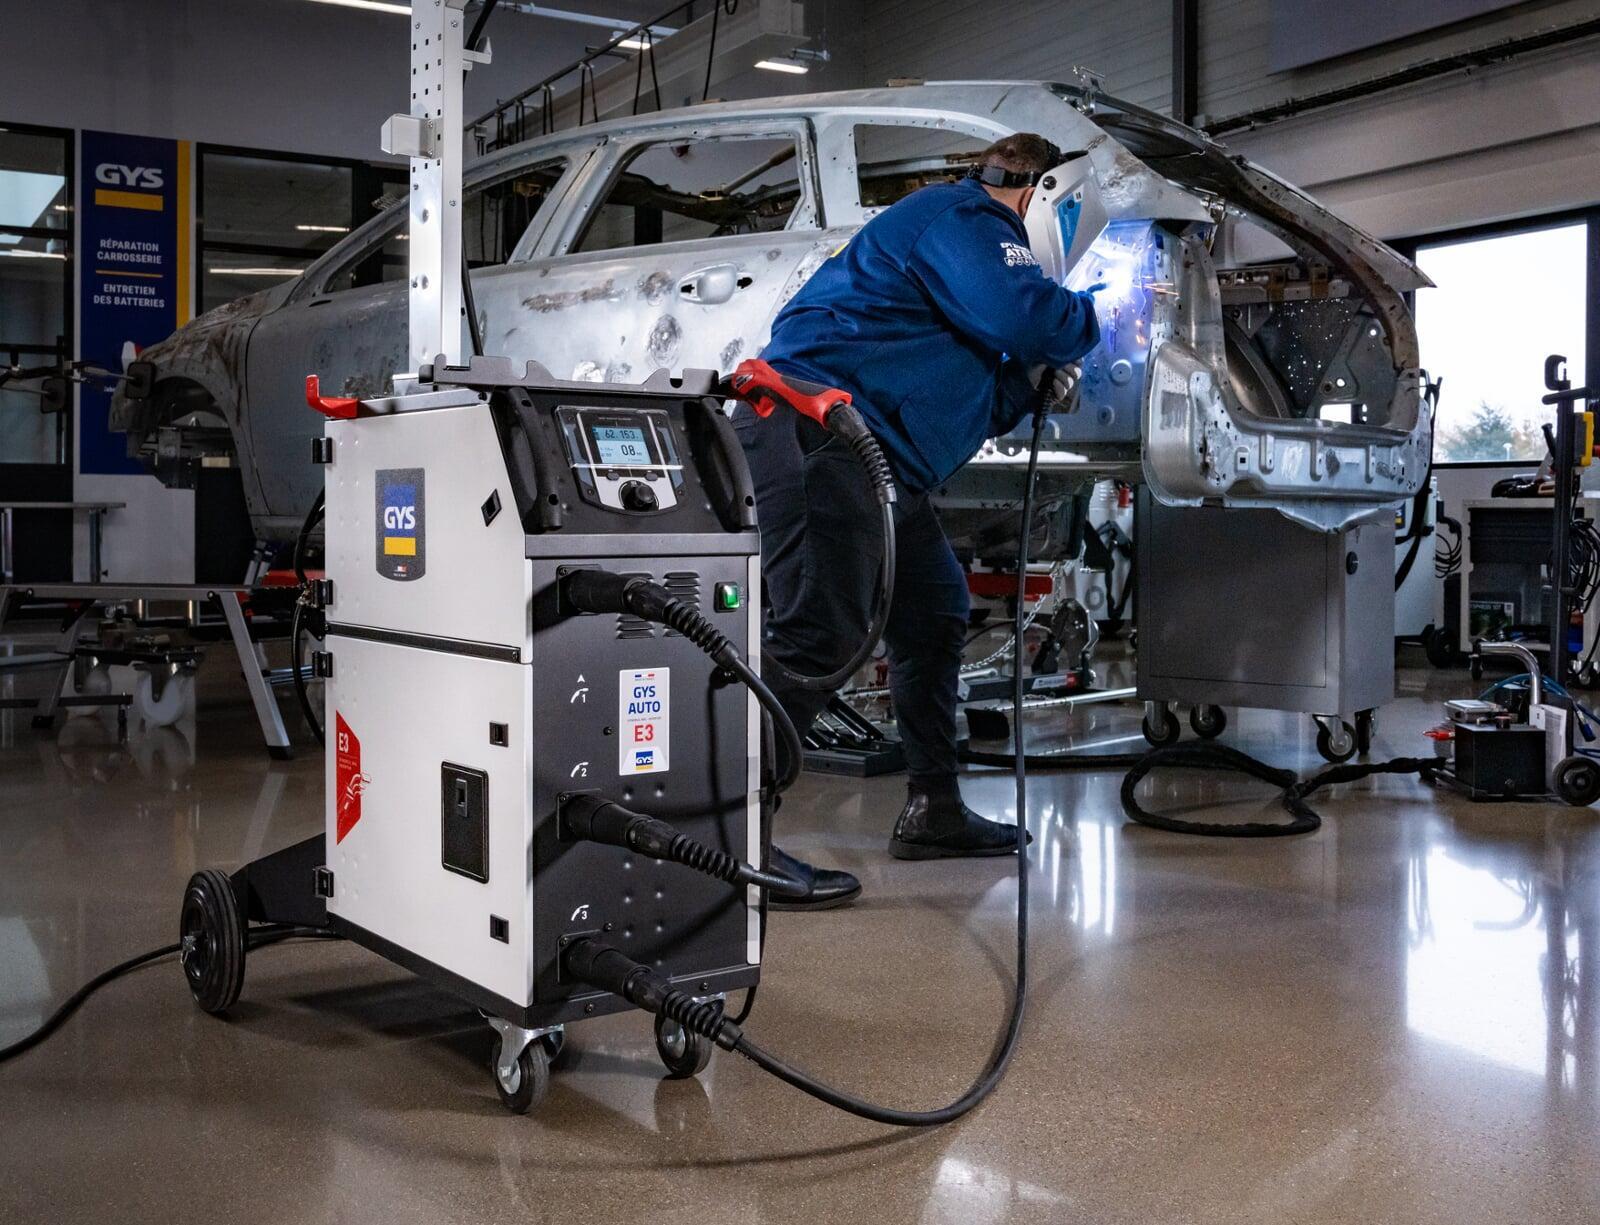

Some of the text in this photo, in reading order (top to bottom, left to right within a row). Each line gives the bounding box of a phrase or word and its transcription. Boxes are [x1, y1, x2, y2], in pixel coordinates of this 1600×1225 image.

[95, 163, 164, 188] GYS
[100, 238, 160, 252] RÉPARATION
[97, 251, 162, 265] CARROSSERIE
[103, 283, 156, 295] ENTRETIEN
[93, 295, 165, 308] DES BATTERIES
[384, 506, 416, 530] GYS
[633, 685, 656, 699] GYS
[628, 701, 661, 715] AUTO
[634, 724, 654, 742] E3
[338, 732, 349, 753] E3
[636, 756, 654, 765] GYS
